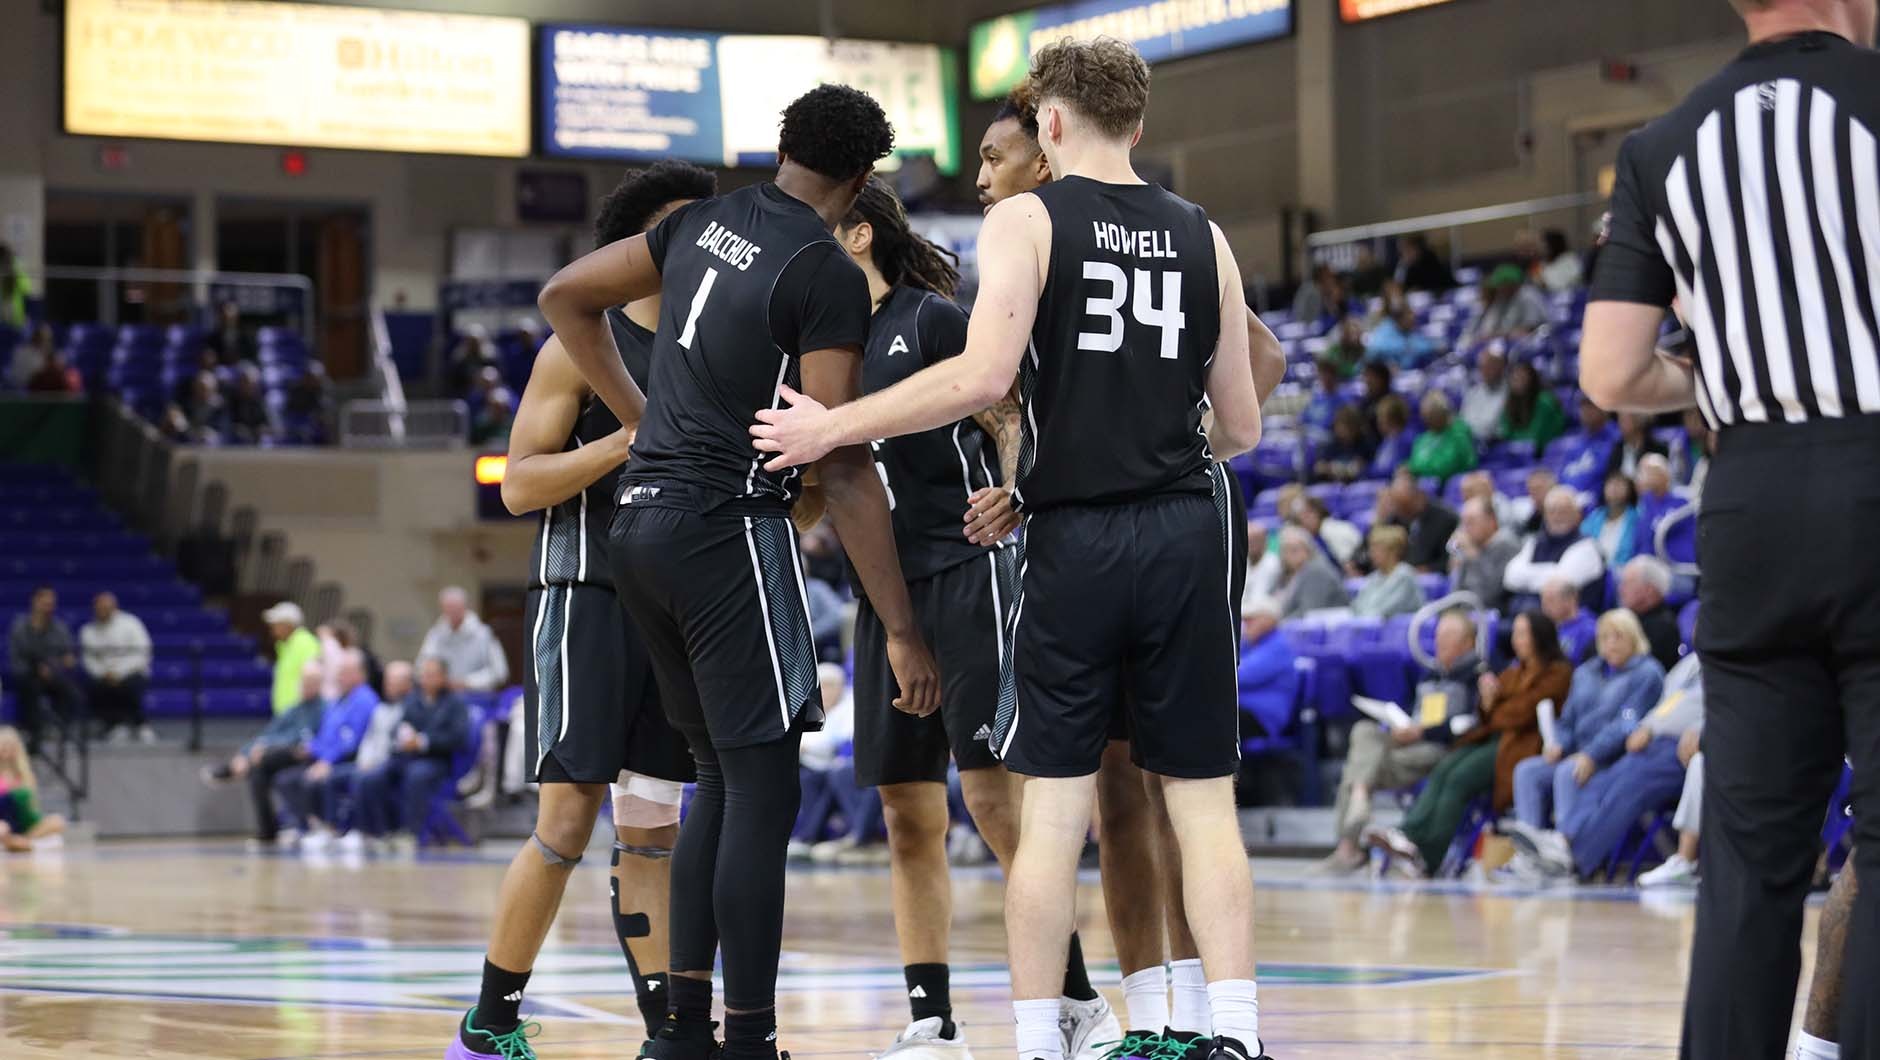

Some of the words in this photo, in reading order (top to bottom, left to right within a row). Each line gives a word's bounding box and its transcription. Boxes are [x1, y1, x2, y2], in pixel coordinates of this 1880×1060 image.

[695, 221, 762, 272] BACCHUS
[1093, 221, 1178, 259] HOWELL
[676, 267, 719, 350] 1
[1077, 261, 1186, 360] 34
